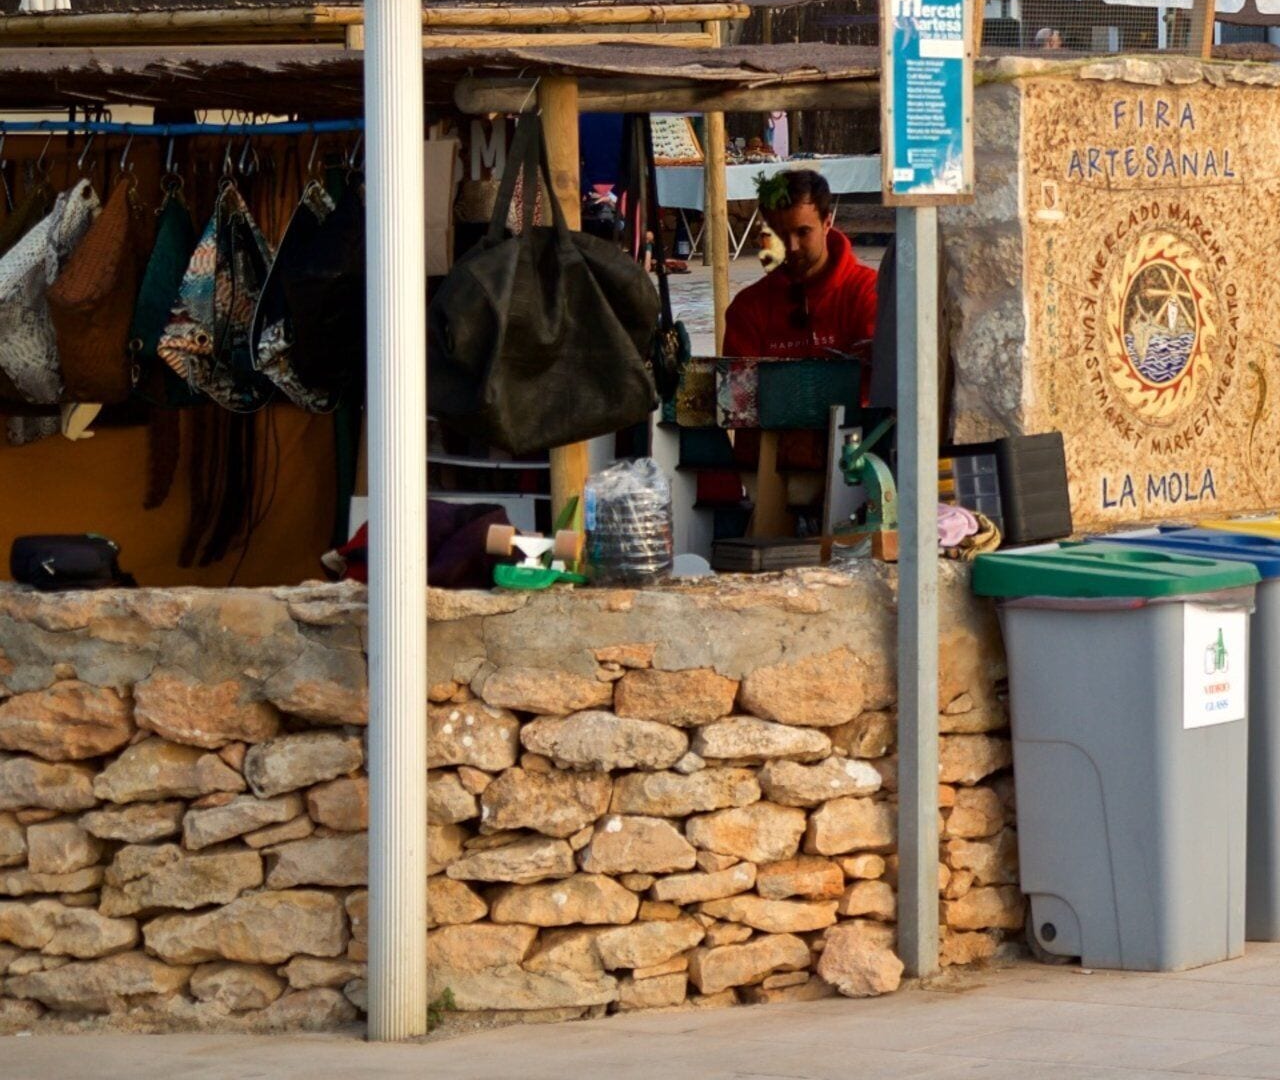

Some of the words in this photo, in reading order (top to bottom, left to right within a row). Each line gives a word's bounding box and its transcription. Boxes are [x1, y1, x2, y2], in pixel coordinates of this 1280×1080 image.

[1113, 100, 1195, 130] FIRA
[1068, 146, 1235, 178] ARTESANAL
[1088, 202, 1160, 289] MERCADO
[1168, 203, 1227, 271] MARCHE
[1081, 296, 1143, 449] KUNSTMARKT
[1214, 283, 1240, 406] MERCATO
[1150, 408, 1211, 456] MARKET
[1102, 474, 1136, 509] LA
[1147, 468, 1216, 504] MOLA
